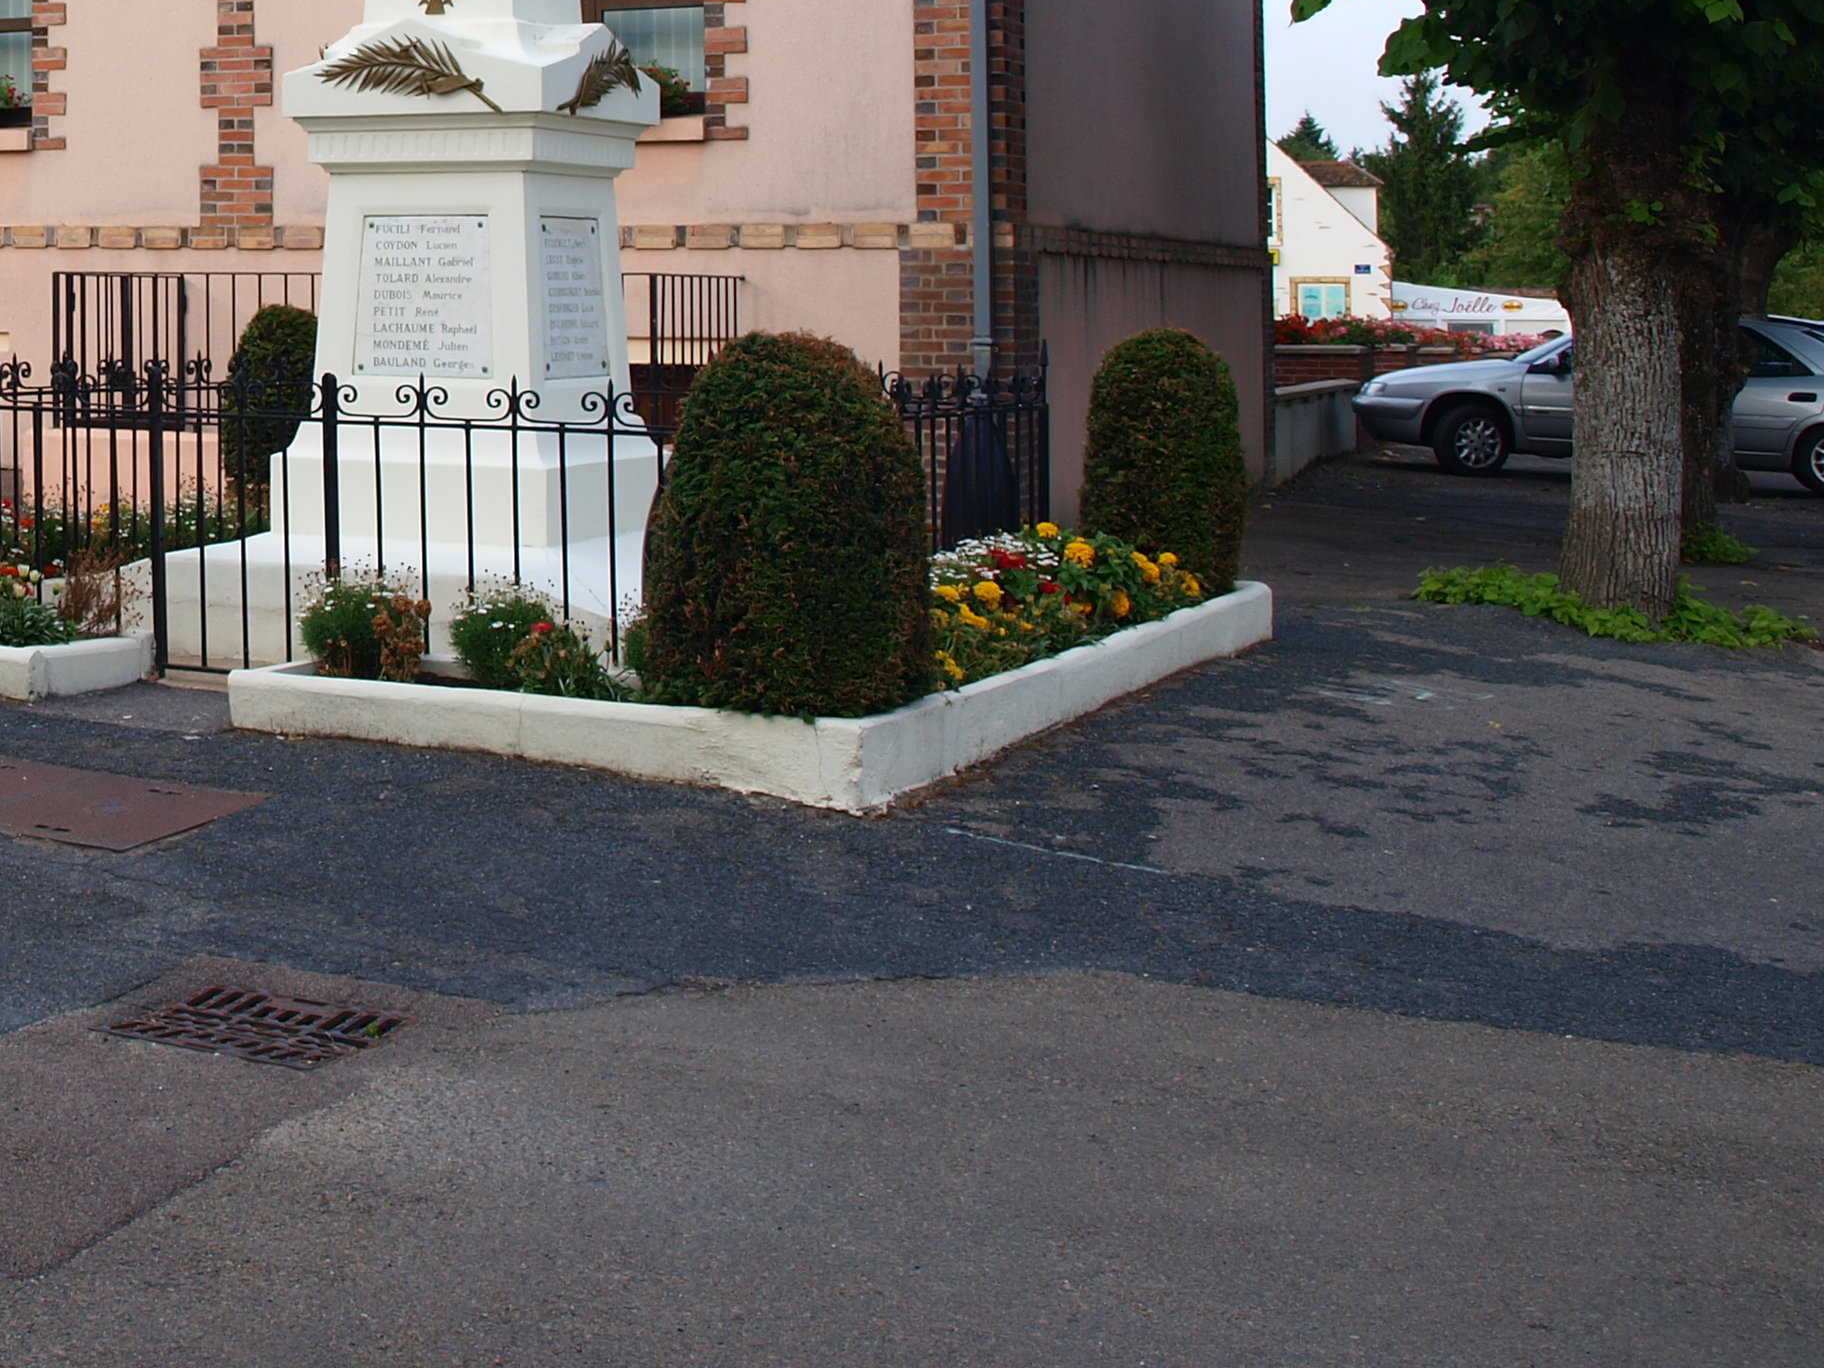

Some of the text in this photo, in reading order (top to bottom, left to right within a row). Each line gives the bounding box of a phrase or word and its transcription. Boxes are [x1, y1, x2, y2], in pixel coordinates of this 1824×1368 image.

[420, 224, 461, 234] Fernand
[426, 240, 458, 250] Lucien
[374, 257, 474, 267] MAILLANT Gabriel
[376, 273, 473, 283] TOLARD Alexandre
[374, 290, 463, 300] DUBOIS Maurice
[1411, 297, 1440, 315] Chez
[1442, 296, 1498, 314] Joëlle
[373, 307, 439, 317] PETIT René
[373, 323, 436, 333] LACHAUME
[437, 340, 469, 351] Julien
[373, 357, 475, 372] BAULAND Georges
